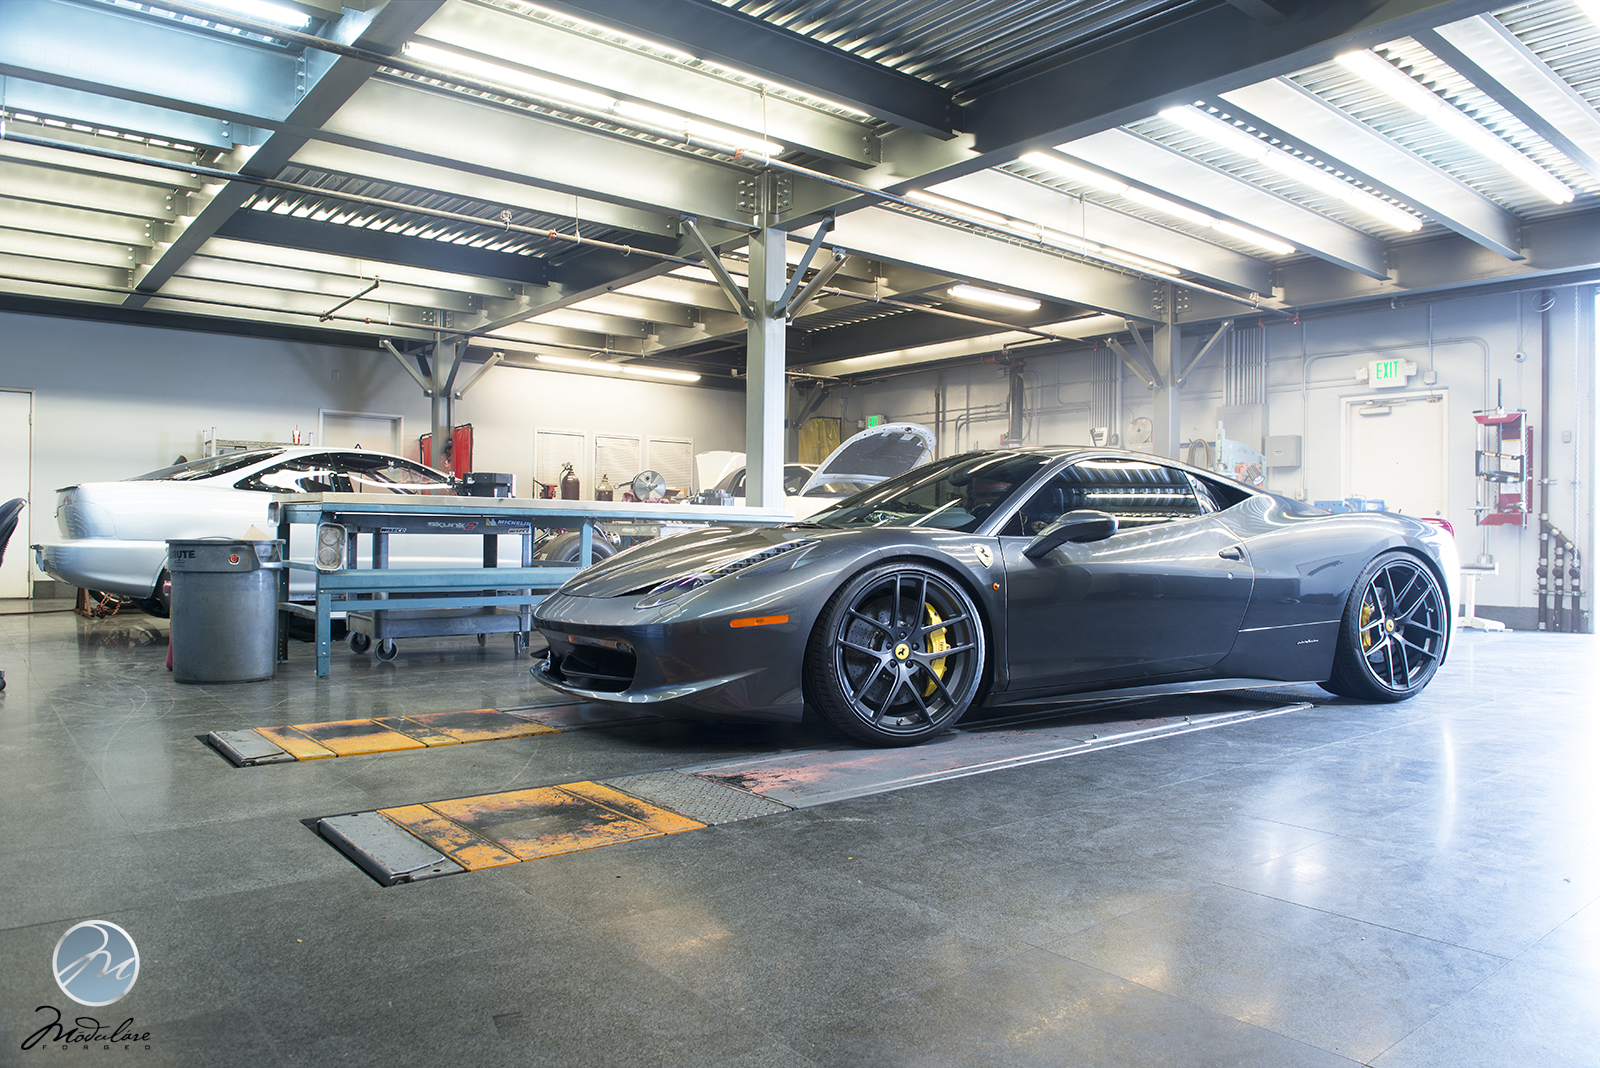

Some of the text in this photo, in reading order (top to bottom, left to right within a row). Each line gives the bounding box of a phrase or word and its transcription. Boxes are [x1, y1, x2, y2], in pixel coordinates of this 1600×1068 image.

[1376, 360, 1399, 379] EXIT
[868, 415, 879, 428] EXIT
[497, 519, 531, 527] MICHELIN
